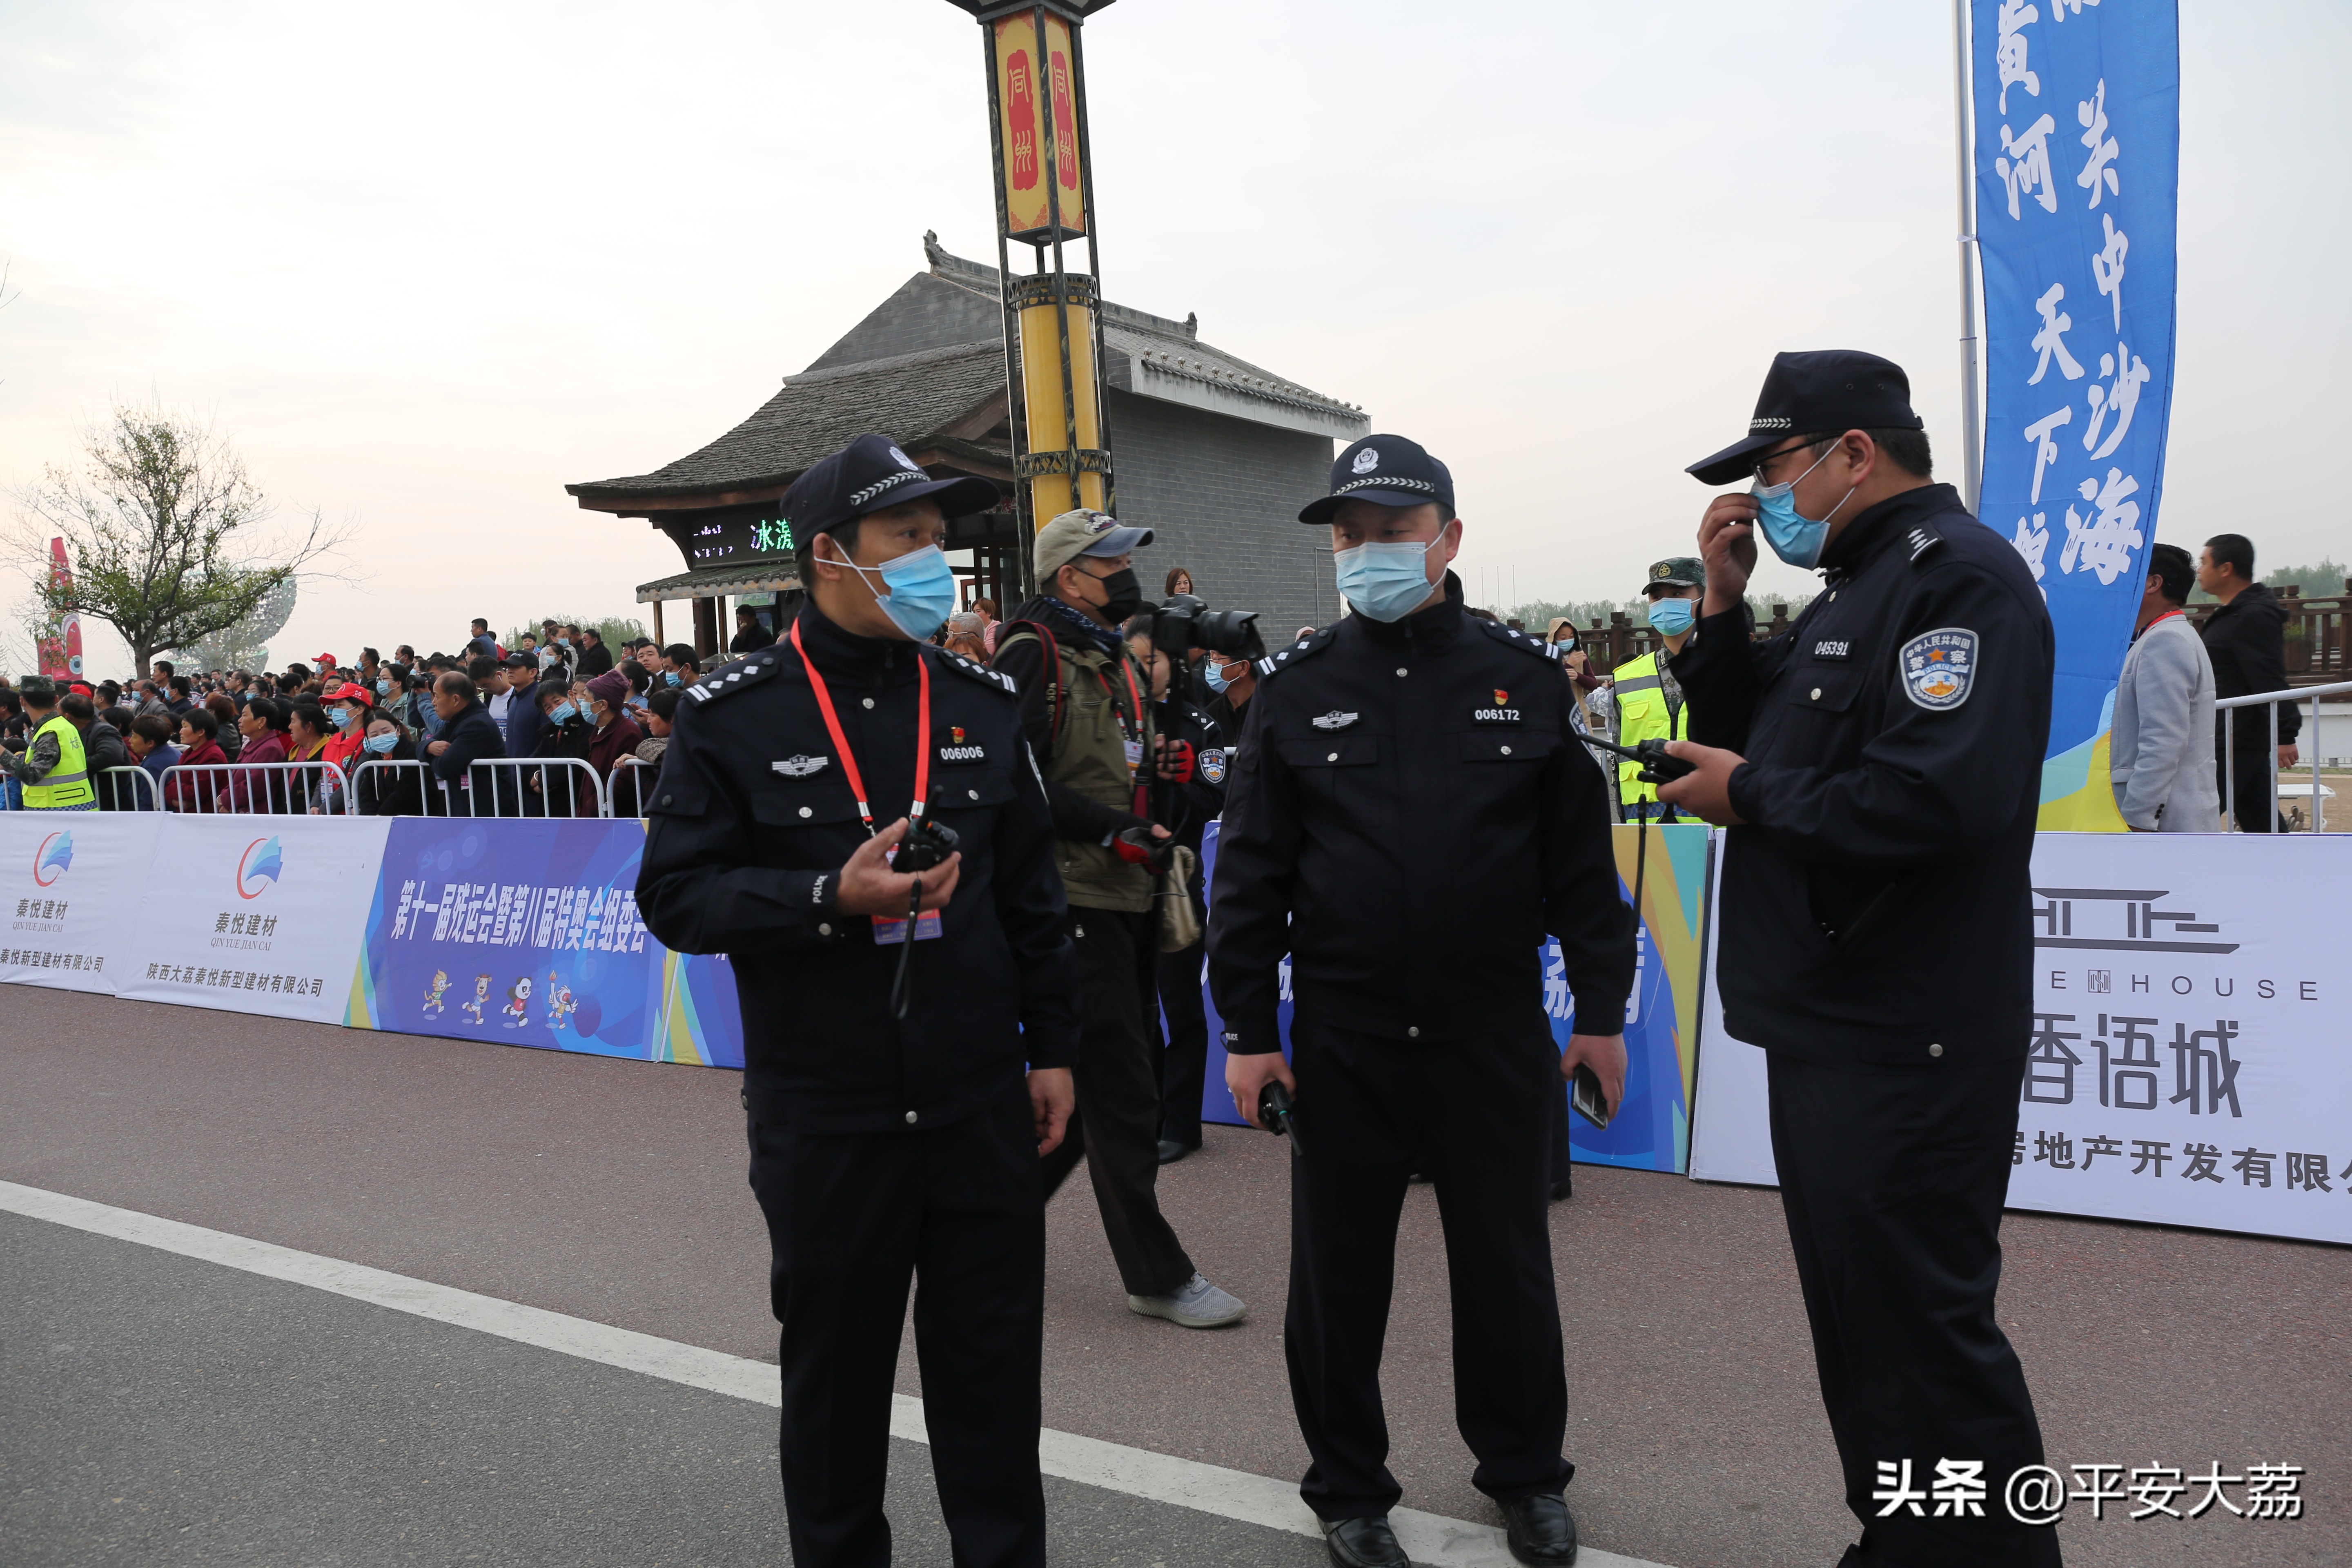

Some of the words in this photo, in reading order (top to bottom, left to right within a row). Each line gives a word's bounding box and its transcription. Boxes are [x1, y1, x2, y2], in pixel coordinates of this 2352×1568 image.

[1815, 641, 1849, 655] 045391
[1906, 635, 1971, 658] 中华人民共和国
[1924, 664, 1953, 674] POLICE
[1475, 709, 1520, 720] 006172
[940, 746, 984, 760] 006006
[16, 898, 68, 920] 秦悦建材
[391, 879, 648, 953] 第十一届残运会暨第八届特奥会组委会
[13, 921, 24, 931] QIN
[26, 922, 38, 931] YUE
[38, 923, 52, 932] JIAN
[53, 924, 63, 933] CAI
[214, 911, 278, 937] 秦悦建材
[211, 938, 225, 948] QIN
[225, 938, 241, 949] YUE
[240, 940, 258, 950] JIAN
[258, 941, 272, 951] CAI
[0, 948, 104, 973] 秦悦新型建材有限公司
[146, 962, 324, 997] 陕西大荔秦悦新型建材有限公司
[2132, 974, 2318, 1001] HOUSE
